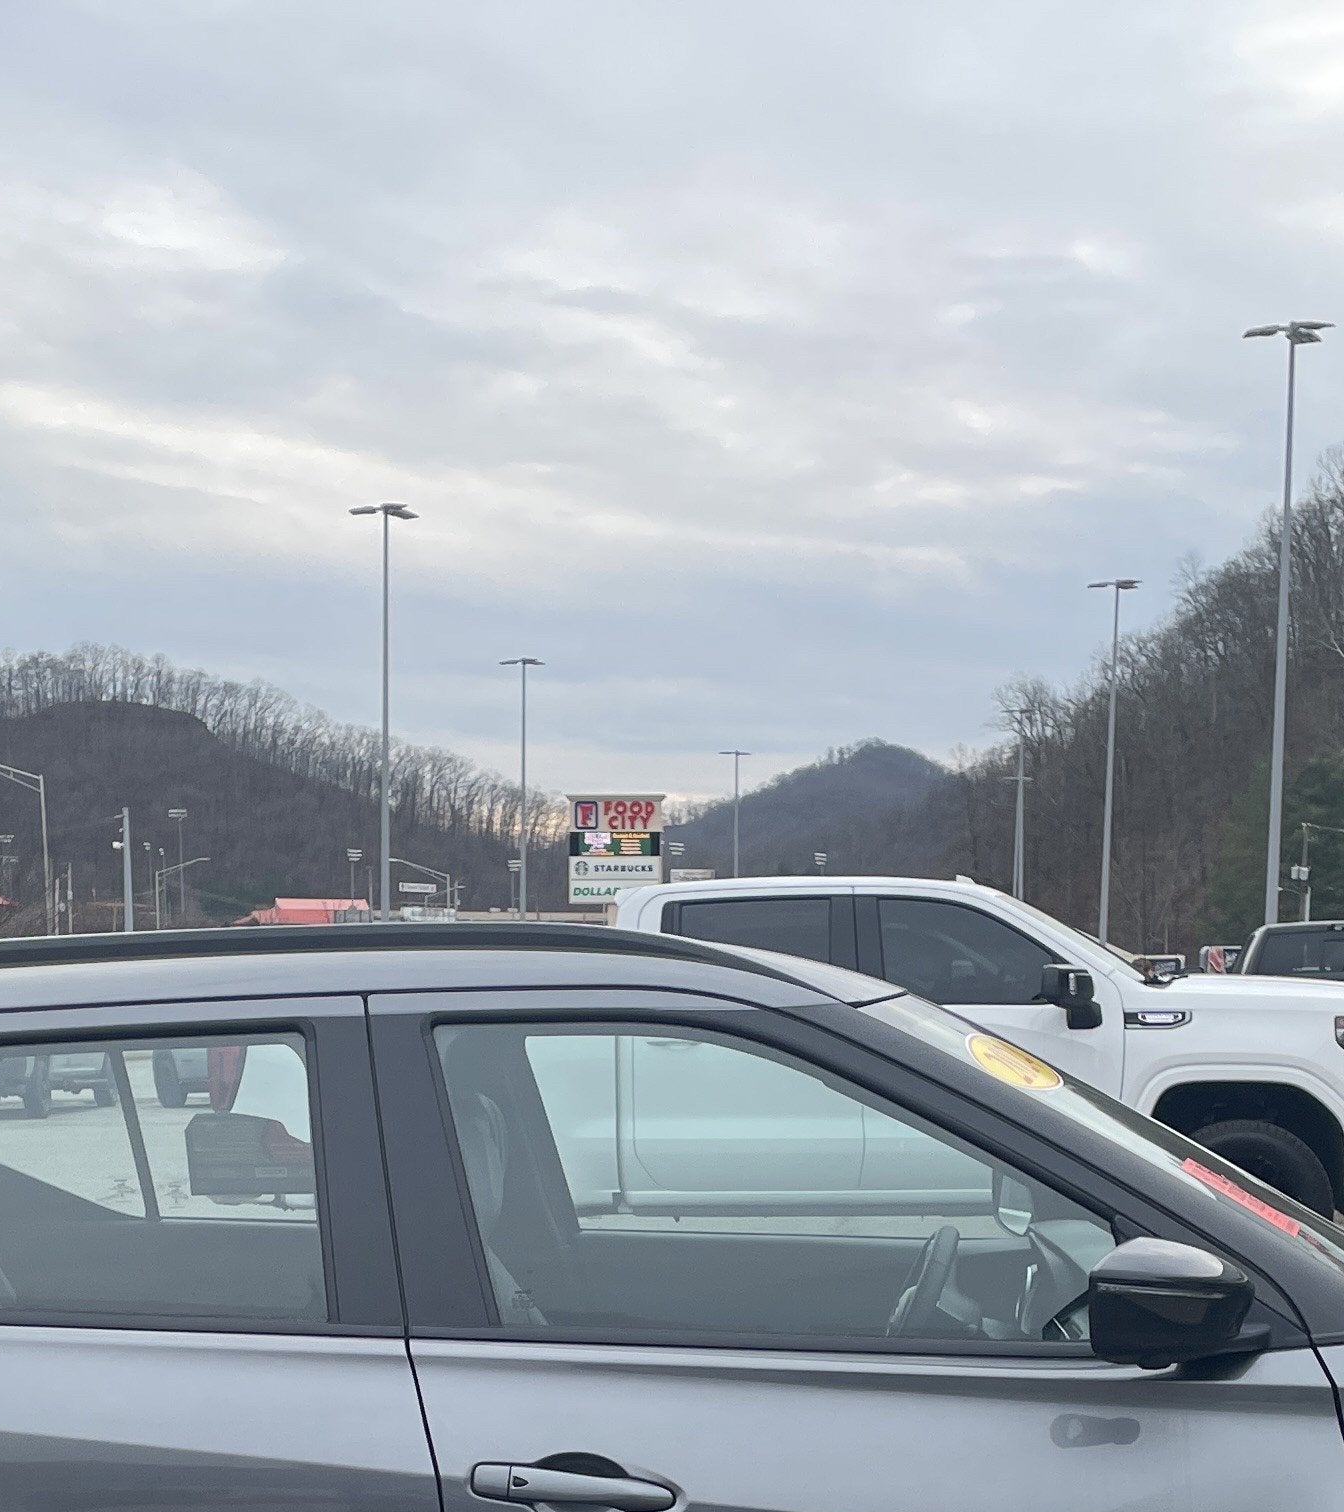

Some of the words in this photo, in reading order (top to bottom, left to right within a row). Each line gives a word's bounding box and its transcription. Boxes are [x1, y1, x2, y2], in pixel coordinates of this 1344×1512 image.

[603, 800, 655, 815] FOOD
[608, 815, 651, 829] CITY
[593, 864, 653, 873] STARBUCKS
